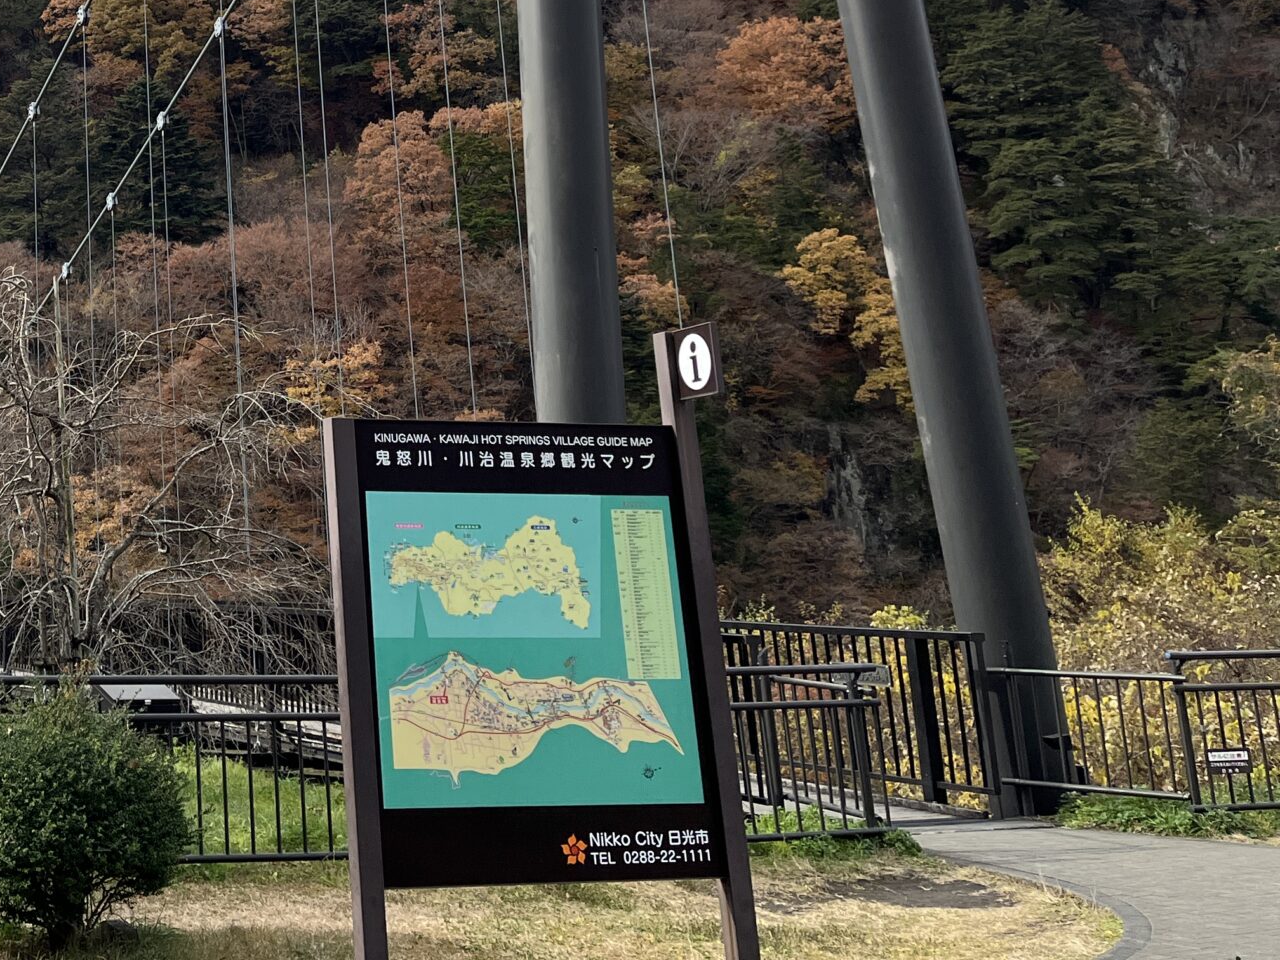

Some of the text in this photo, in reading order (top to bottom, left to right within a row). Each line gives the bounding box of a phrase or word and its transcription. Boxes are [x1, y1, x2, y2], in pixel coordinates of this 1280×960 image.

[373, 432, 432, 444] KINUGAWA
[439, 433, 479, 445] KAWAJI
[480, 434, 503, 445] HOT
[505, 434, 551, 446] SPRINGS
[552, 435, 595, 447] VILLAGE
[596, 436, 629, 447] GUIDE
[630, 437, 653, 447] MAP
[589, 828, 710, 848] Nikko City 日光市
[590, 848, 711, 865] TEL 0288-22-1111
